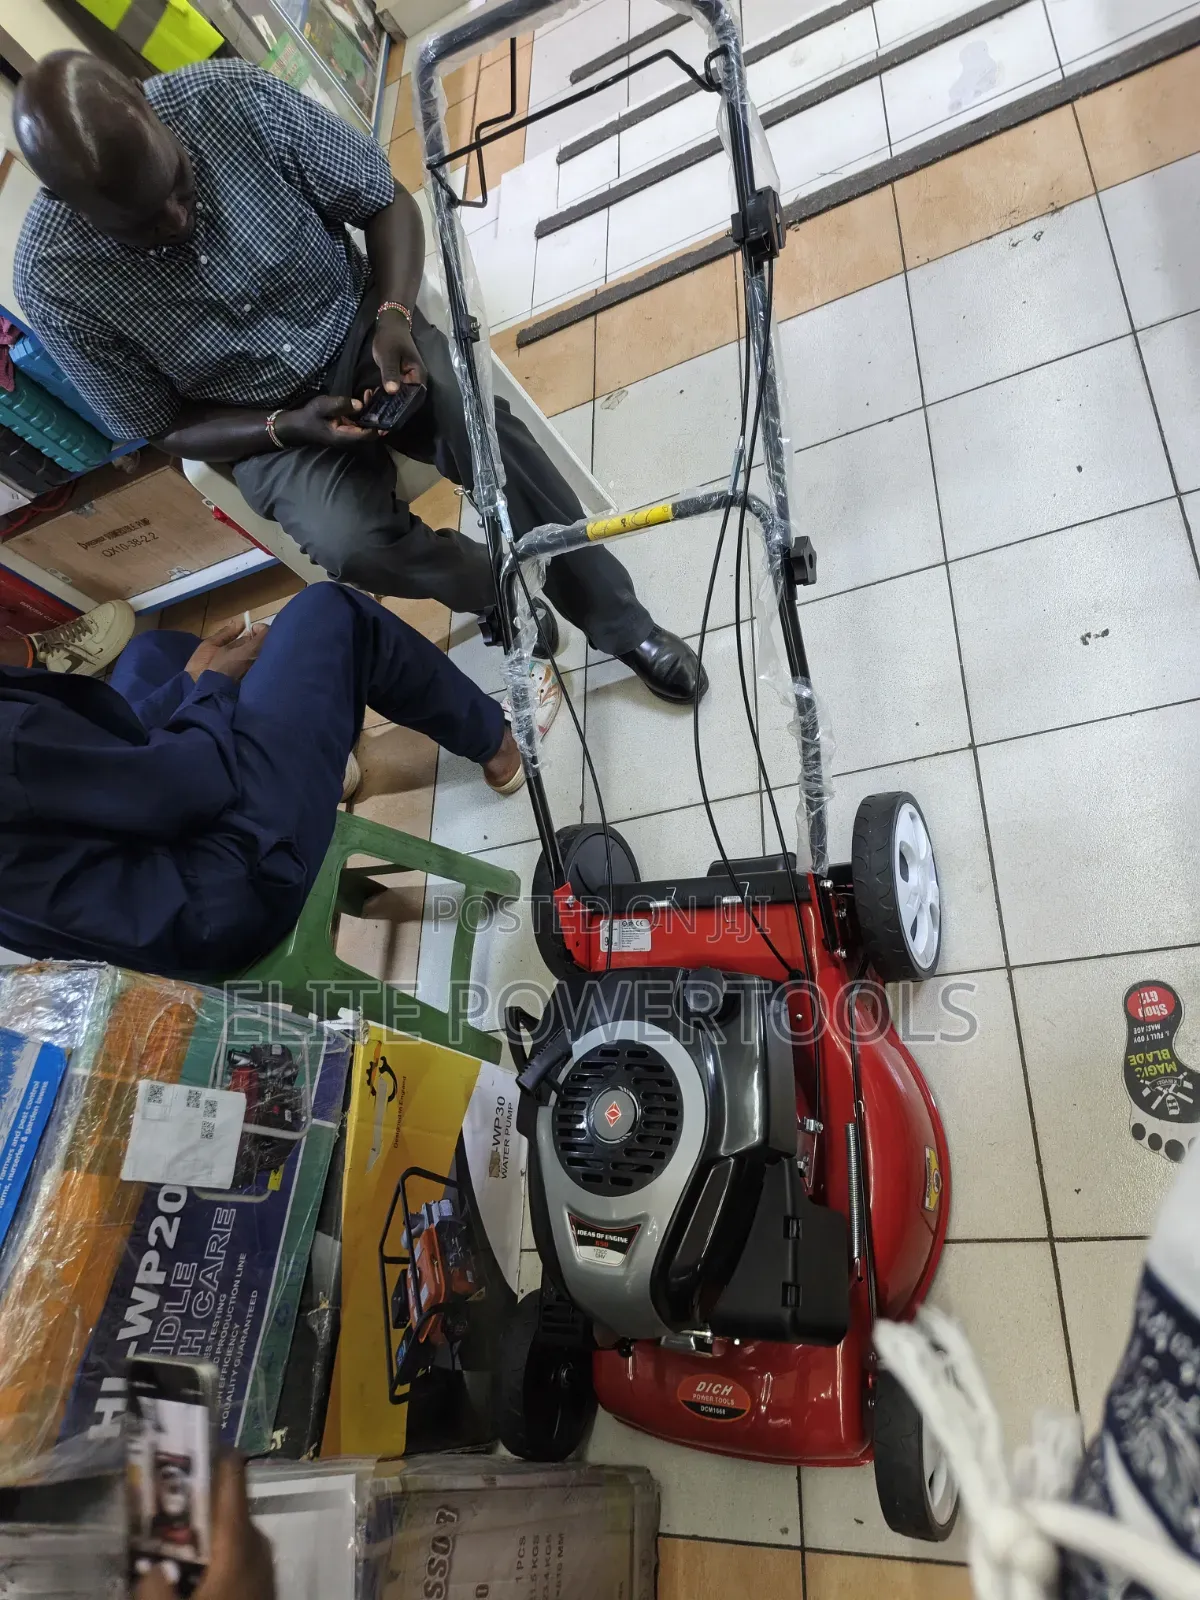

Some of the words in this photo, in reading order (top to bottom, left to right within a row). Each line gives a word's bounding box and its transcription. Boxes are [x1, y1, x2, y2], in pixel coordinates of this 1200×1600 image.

[1138, 1003, 1168, 1018] Shop
[1150, 1031, 1164, 1041] FULL
[1128, 1048, 1171, 1066] BLADE
[1135, 1061, 1178, 1078] MAGIC
[8, 1143, 25, 1181] nurseries
[25, 1105, 40, 1135] garden
[38, 1080, 49, 1105] lawns
[11, 1130, 20, 1147] and
[18, 1111, 29, 1130] pest
[26, 1080, 40, 1110] control
[505, 1102, 514, 1136] PUMP
[501, 1139, 511, 1179] WATER
[577, 1229, 596, 1238] IDEAS
[605, 1234, 629, 1244] ENGINE
[192, 1207, 236, 1319] CARE
[208, 1293, 227, 1342] TESTING
[219, 1279, 241, 1355] PRODUCTION
[235, 1252, 247, 1277] LINE
[218, 1322, 240, 1389] EFFICIENCY
[222, 1370, 239, 1420] QUALITY
[233, 1289, 258, 1367] GUARANTEED
[692, 1393, 714, 1402] POWER
[715, 1396, 735, 1406] TOOLS
[695, 1381, 733, 1395] DICH
[515, 1535, 526, 1570] PCS
[531, 1534, 540, 1569] KGS
